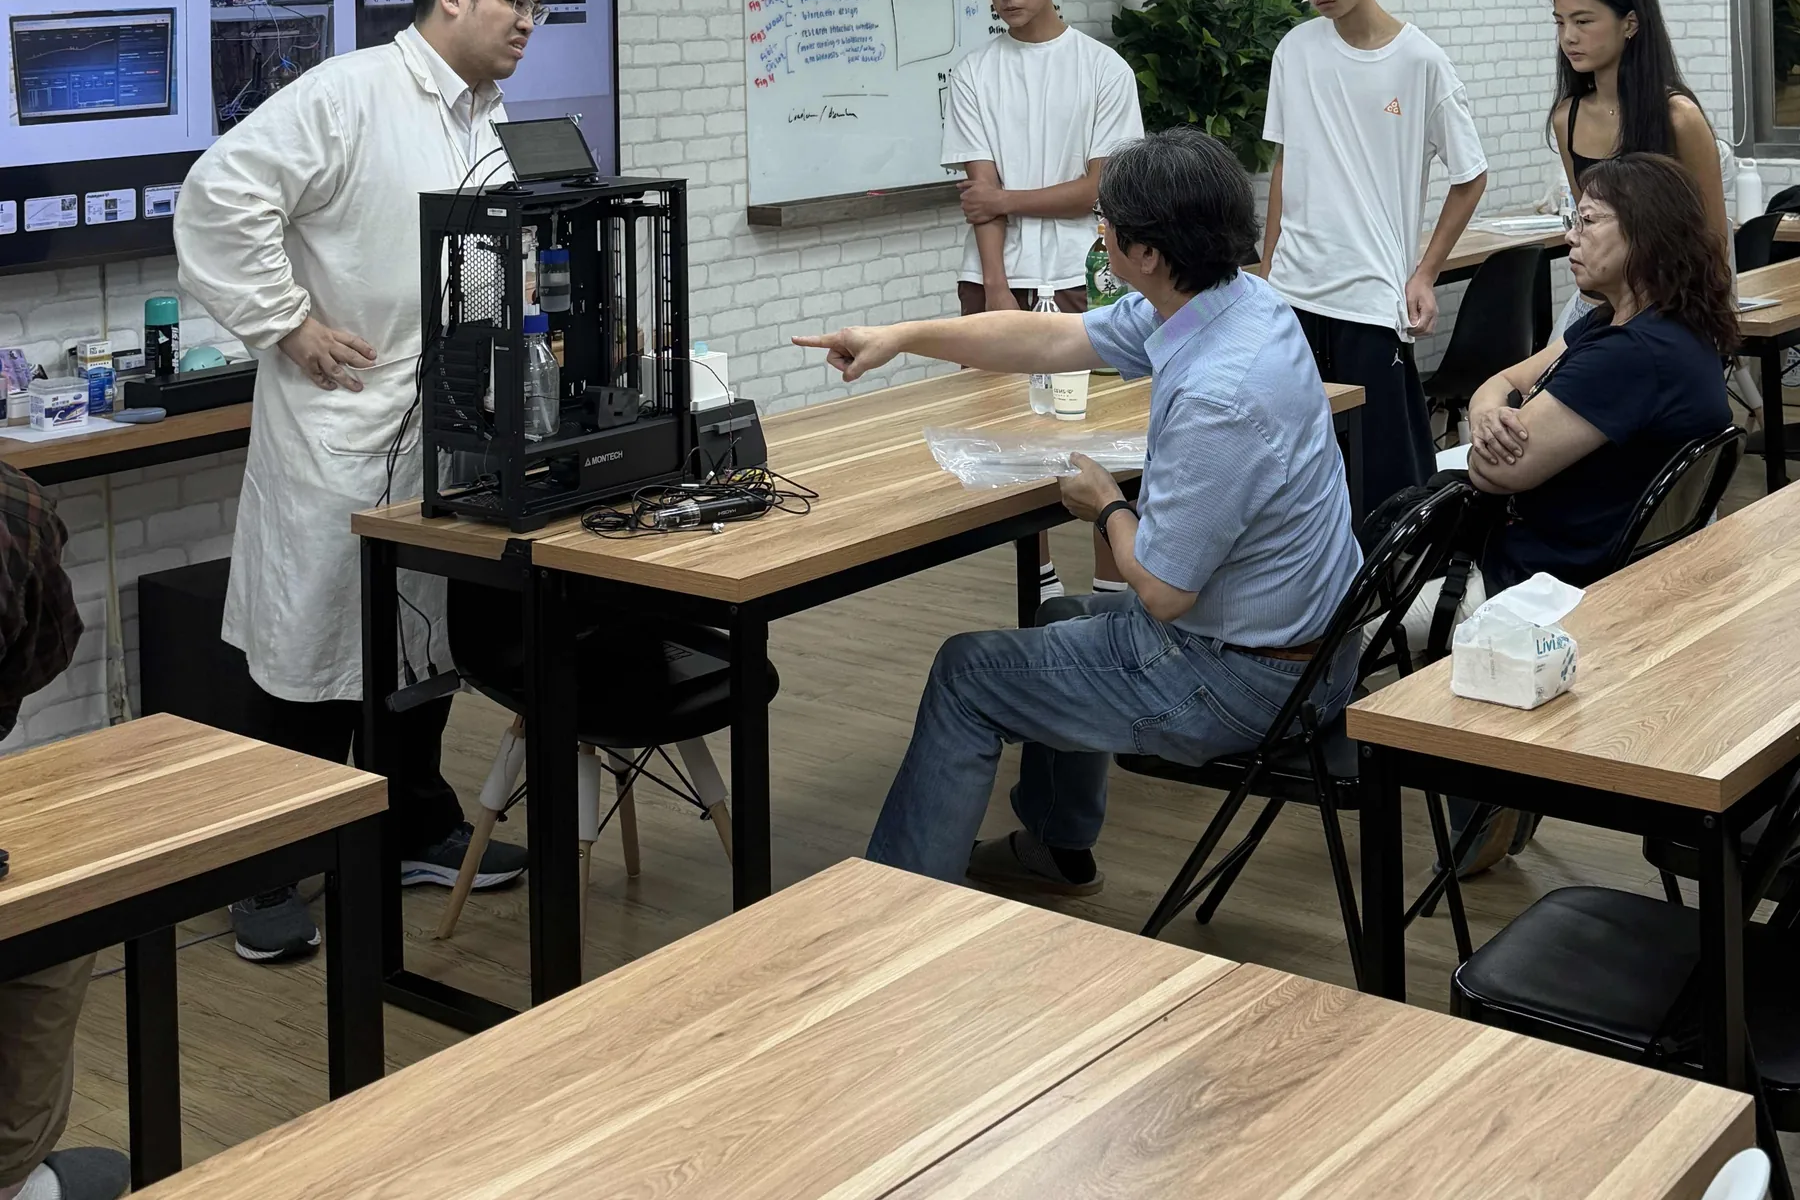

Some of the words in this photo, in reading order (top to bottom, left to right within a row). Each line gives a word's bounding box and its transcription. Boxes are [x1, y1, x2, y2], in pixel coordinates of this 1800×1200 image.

[749, 0, 762, 12] Fig
[755, 78, 768, 88] Fig
[768, 73, 775, 83] 4
[592, 450, 623, 465] MONTECH
